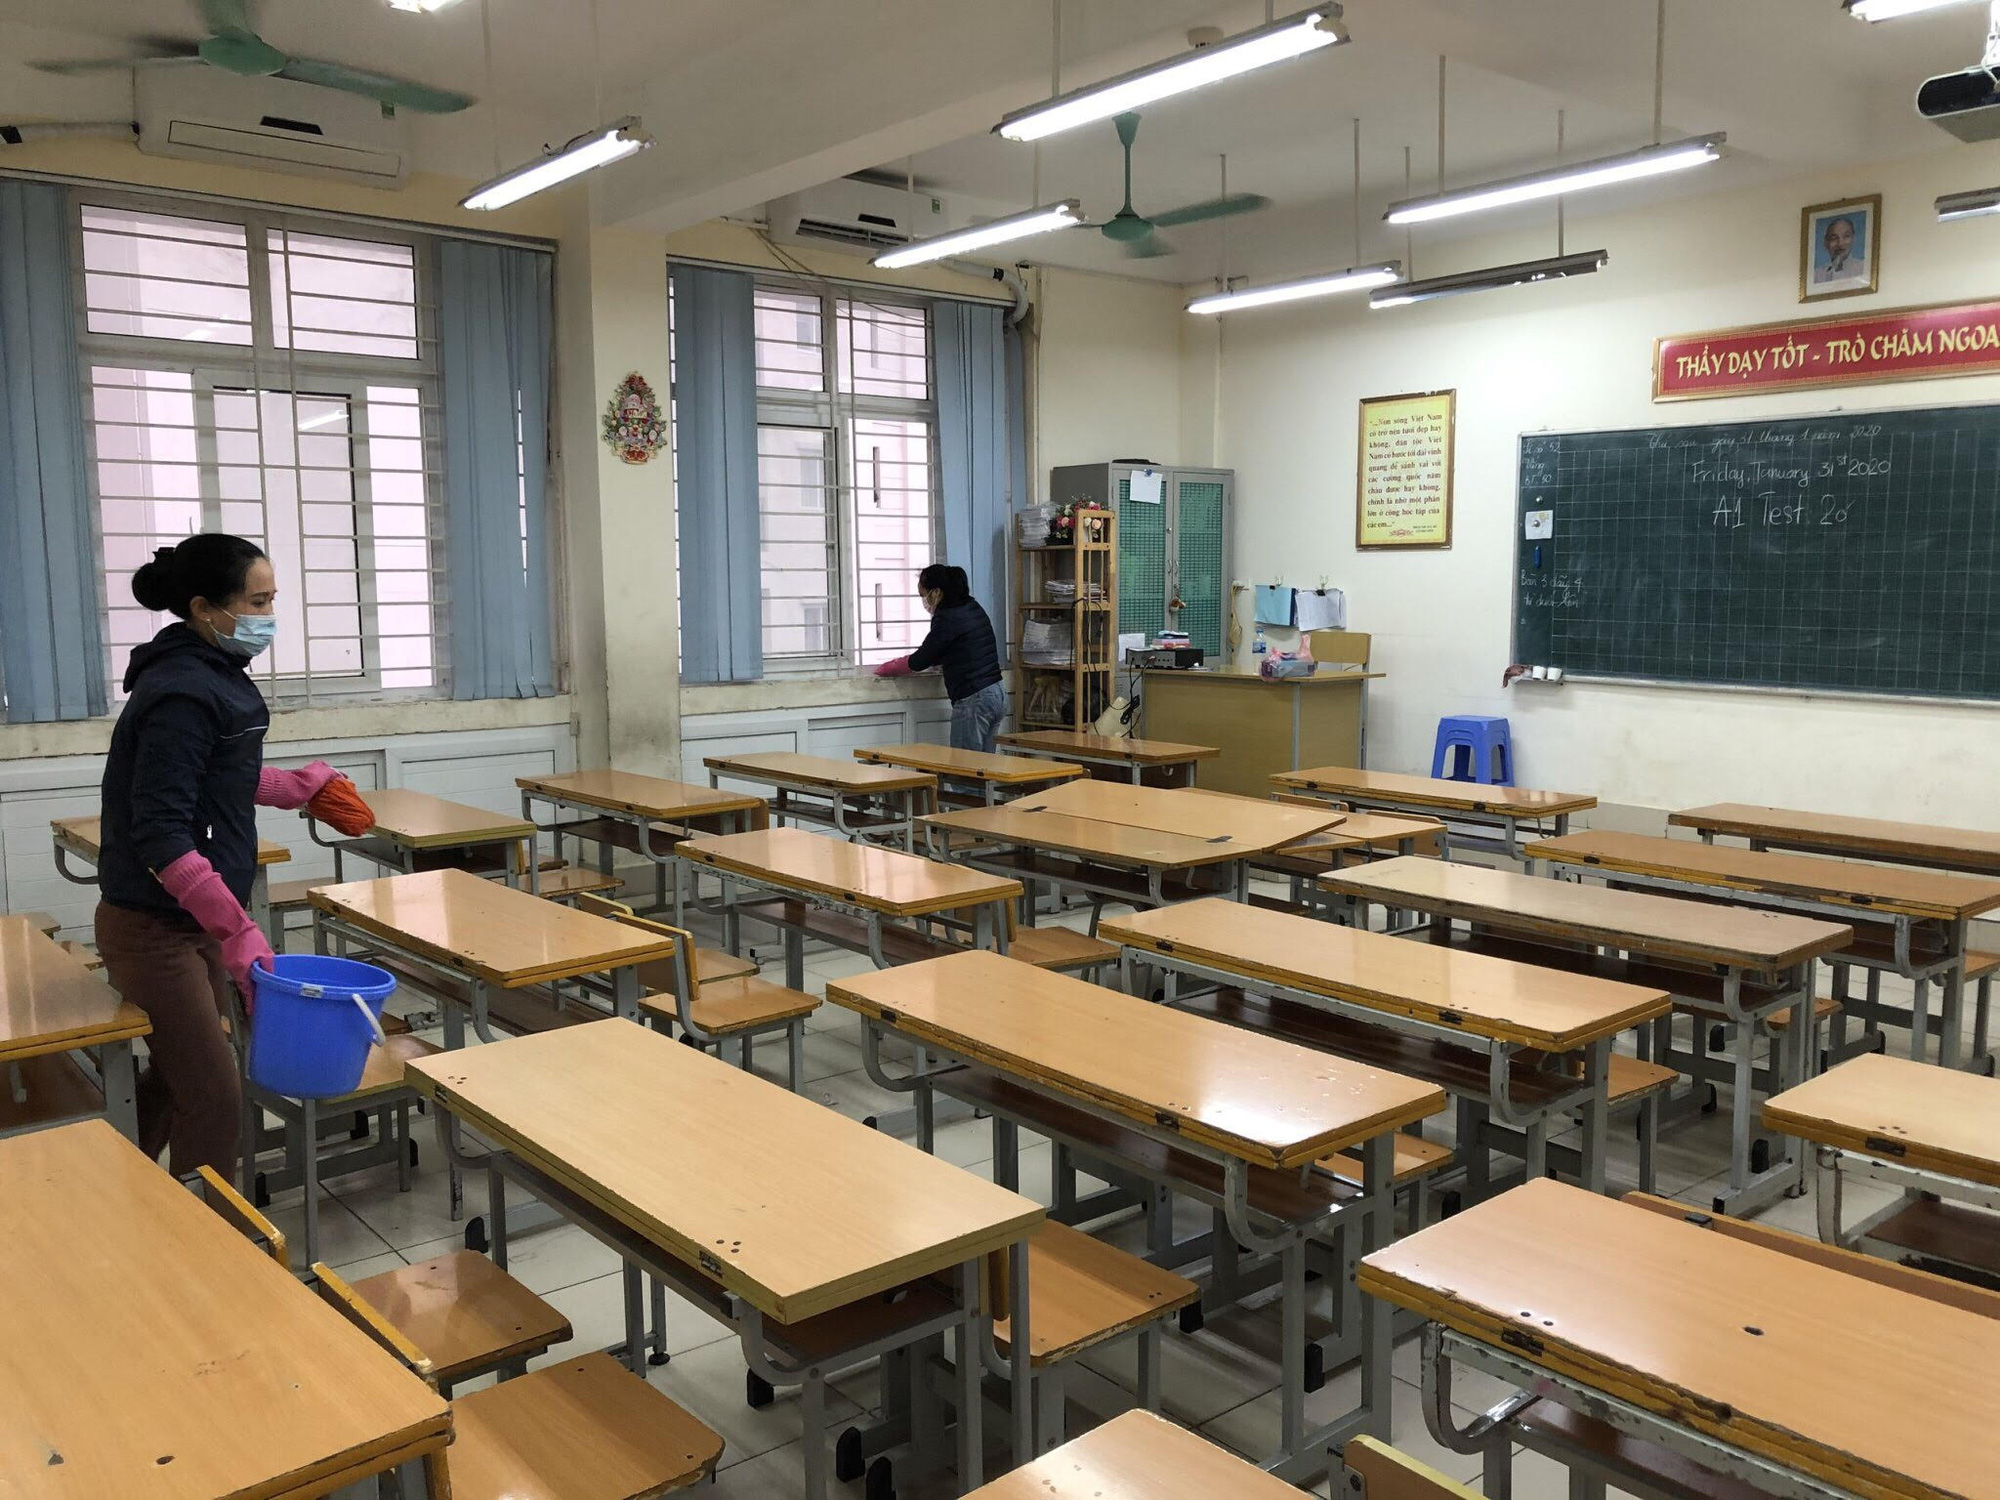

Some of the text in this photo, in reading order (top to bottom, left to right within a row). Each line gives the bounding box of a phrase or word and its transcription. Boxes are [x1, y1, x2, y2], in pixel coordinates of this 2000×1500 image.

[1728, 347, 1768, 379] DẠY
[1771, 334, 1810, 370] TỐT
[1825, 332, 1866, 364] TRÒ
[1870, 328, 1934, 360] CHĂM
[1848, 458, 1891, 476] 2020
[1712, 495, 1745, 529] A1
[1758, 491, 1804, 526] Test
